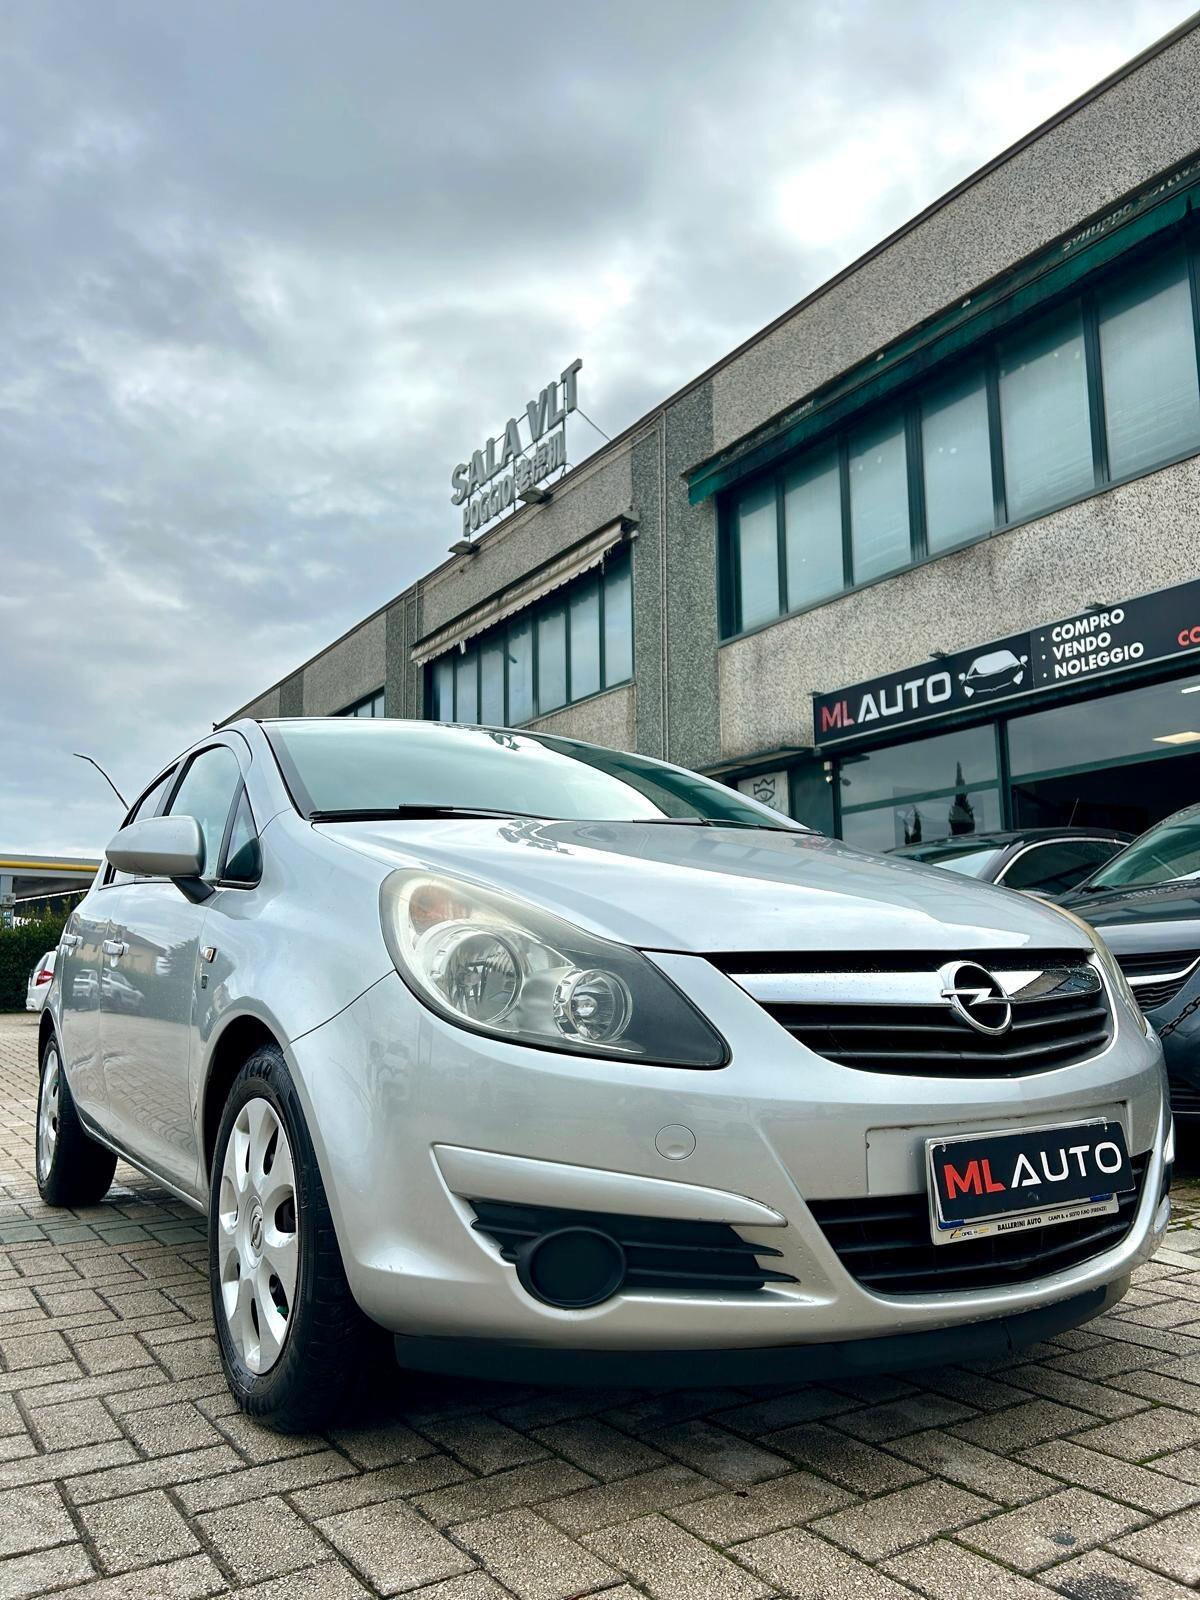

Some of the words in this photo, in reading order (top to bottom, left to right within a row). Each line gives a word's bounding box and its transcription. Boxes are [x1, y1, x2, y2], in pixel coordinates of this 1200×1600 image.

[451, 417, 522, 506] SALA
[526, 358, 583, 443] VLT
[463, 475, 515, 537] POGGIO
[1051, 608, 1125, 642] COMPRO
[1052, 632, 1111, 660] VENDO
[1054, 642, 1144, 679] NOLEGGIO
[944, 1159, 1005, 1200] ML
[1011, 1141, 1122, 1188] AUTO
[997, 1220, 1025, 1231] BALLERINI
[1027, 1217, 1042, 1226] AUTO
